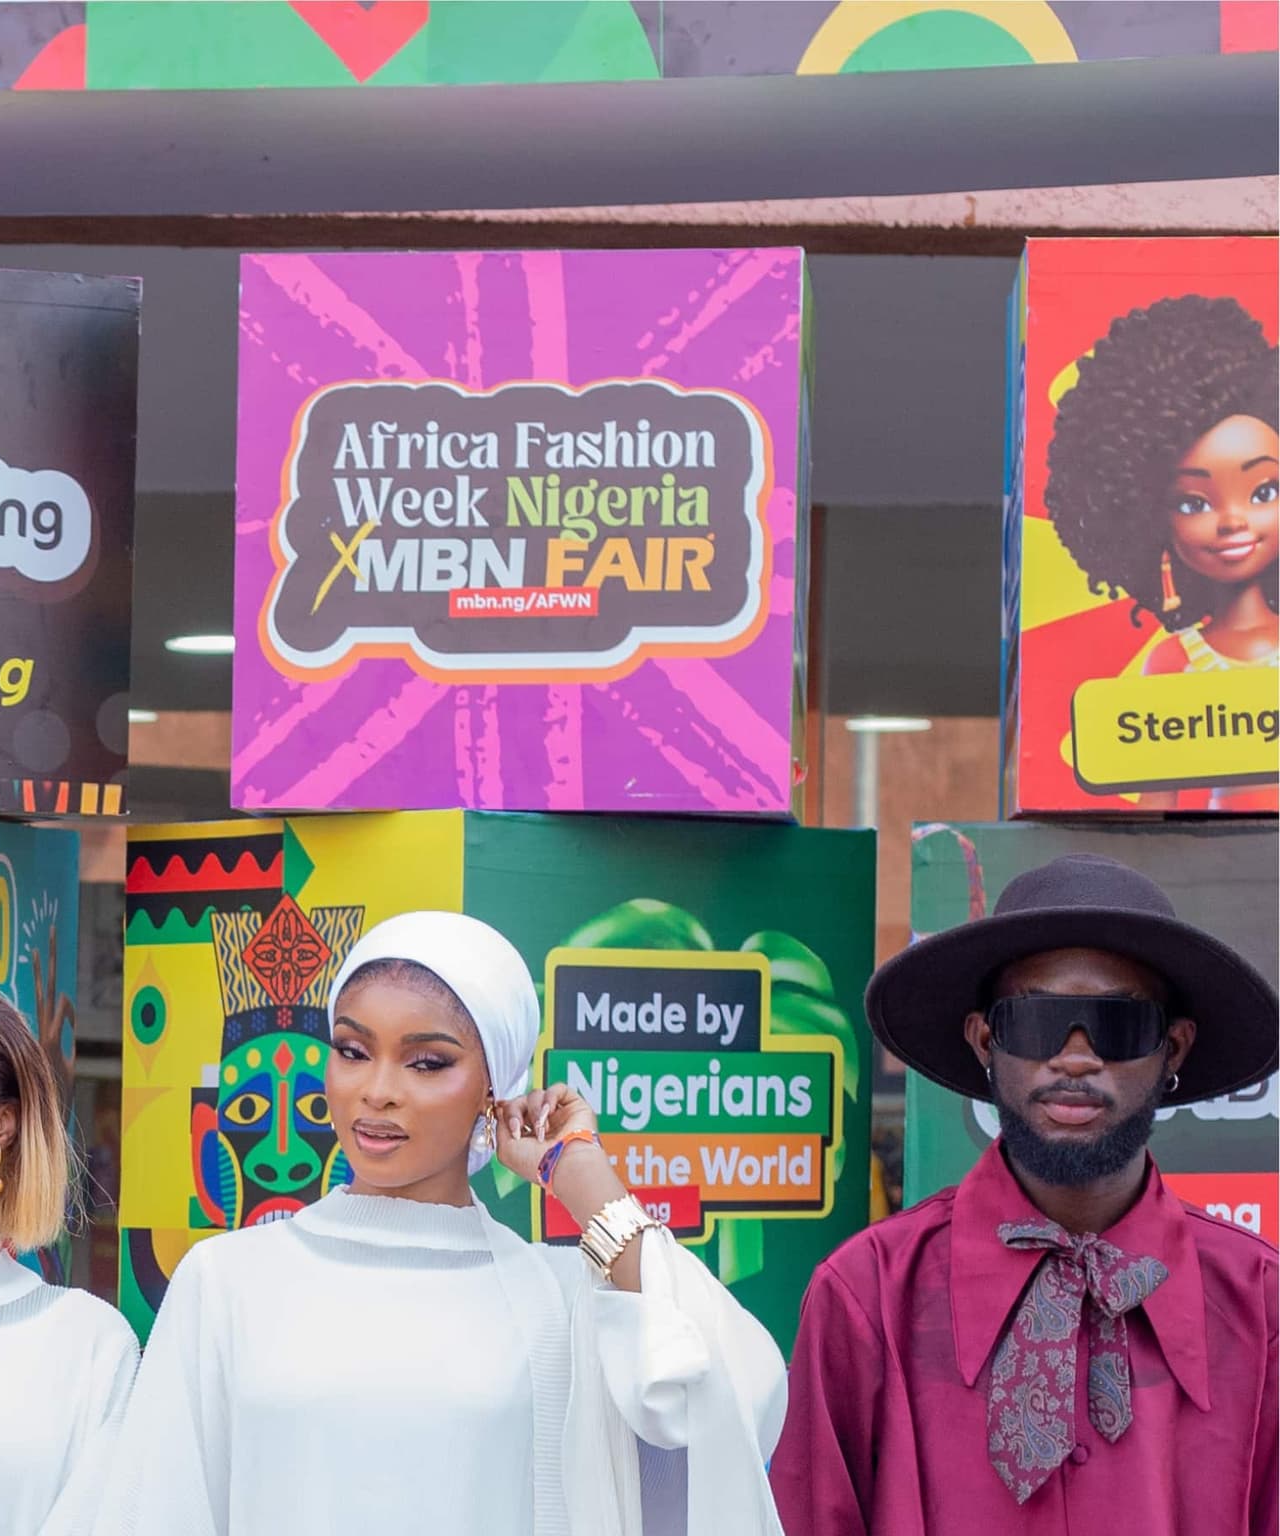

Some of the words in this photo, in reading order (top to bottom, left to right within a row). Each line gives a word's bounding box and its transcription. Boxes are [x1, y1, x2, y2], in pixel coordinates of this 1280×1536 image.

[333, 420, 498, 469] Africa
[515, 418, 716, 468] Fashion
[333, 475, 489, 528] Week
[505, 473, 710, 543] Nigeria
[546, 535, 716, 592] FAIR
[456, 592, 592, 614] mbn.ng/AFWN
[576, 992, 687, 1034] Made
[696, 993, 744, 1045] by
[567, 1057, 812, 1130] Nigerians
[625, 1146, 691, 1185] the
[699, 1146, 812, 1186] World
